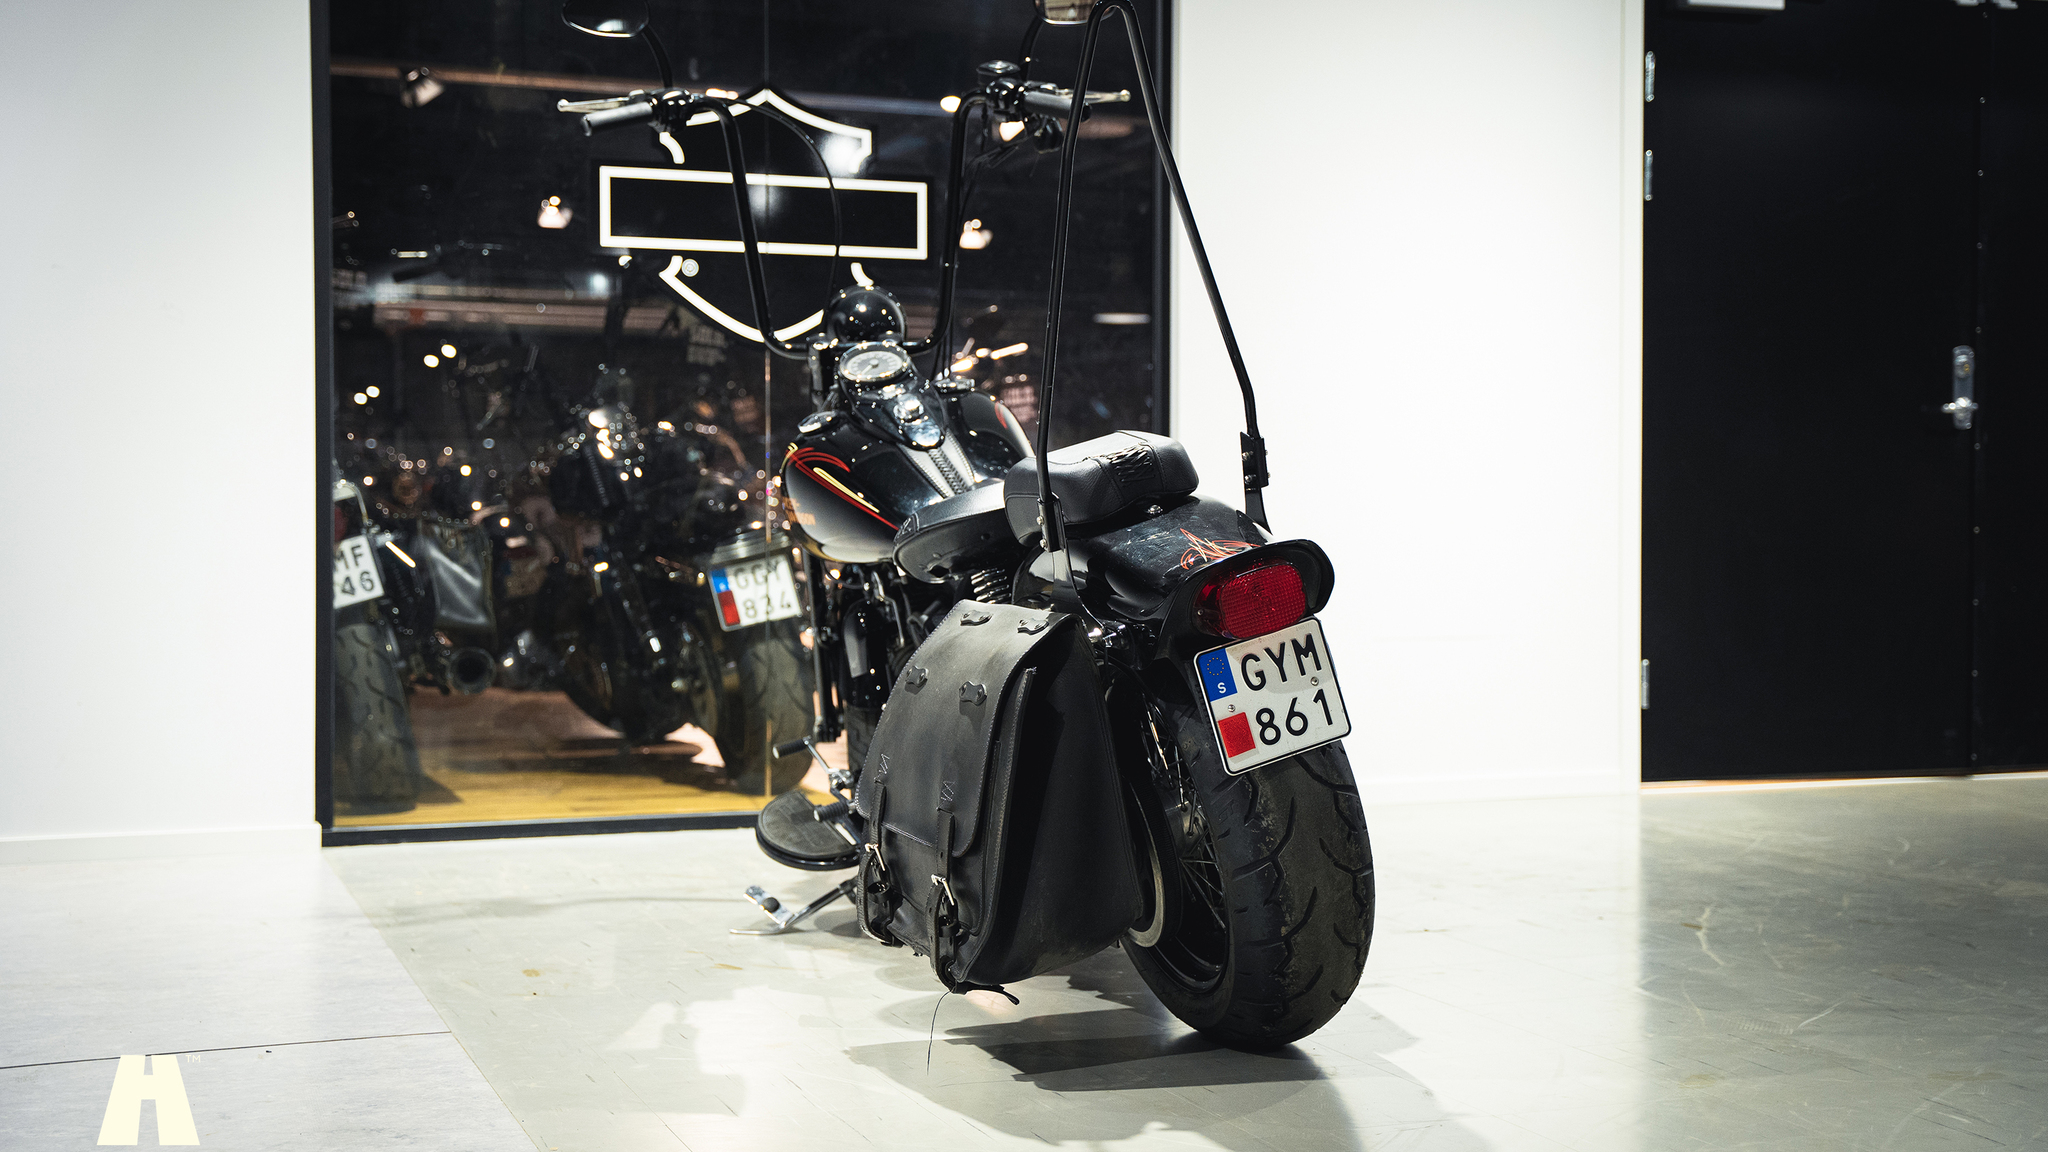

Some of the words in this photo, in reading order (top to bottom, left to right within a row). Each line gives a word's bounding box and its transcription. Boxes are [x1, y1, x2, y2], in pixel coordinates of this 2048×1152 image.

[1217, 682, 1227, 694] S
[1240, 632, 1322, 692] GYM
[1255, 688, 1333, 746] 861
